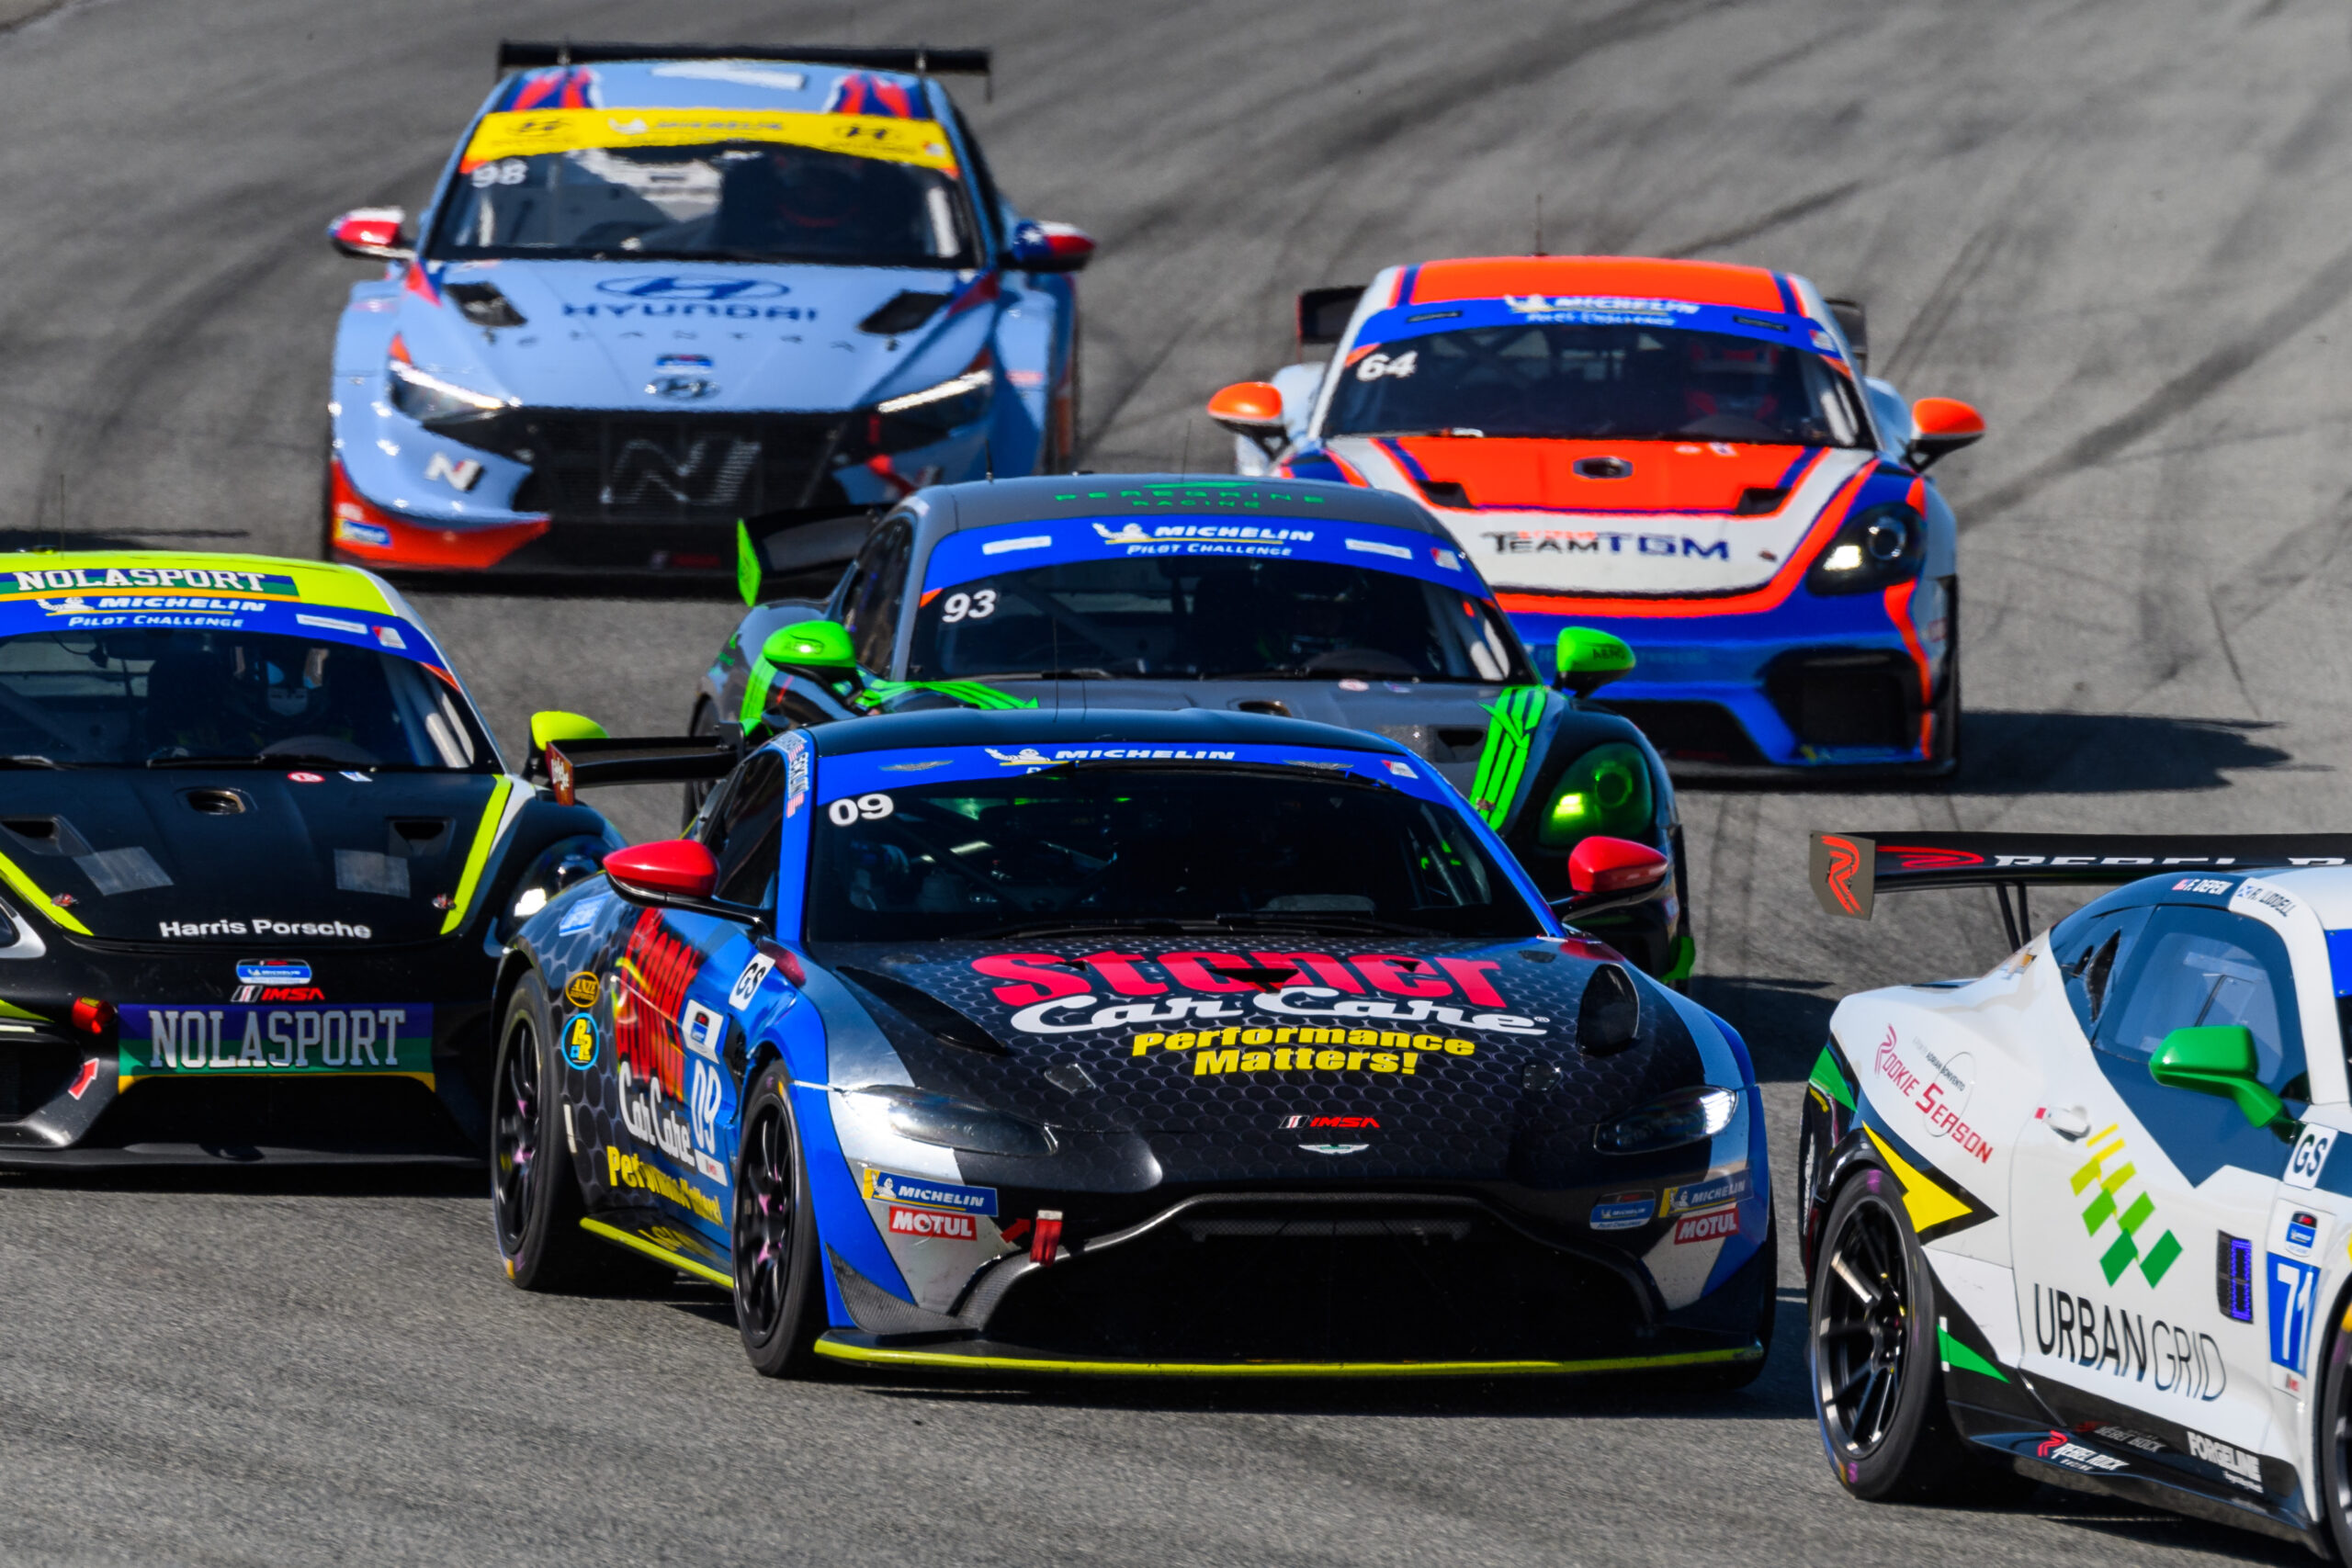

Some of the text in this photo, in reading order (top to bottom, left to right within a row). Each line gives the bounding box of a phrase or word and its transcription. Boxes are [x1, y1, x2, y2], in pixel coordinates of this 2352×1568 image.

[471, 158, 529, 187] 98
[562, 303, 818, 321] HYUNDAI
[1355, 350, 1419, 382] 64
[1154, 525, 1315, 542] MICHELIN
[1126, 543, 1294, 557] PILOT CHALLENGE
[12, 568, 266, 592] NOLASPORT
[97, 596, 267, 612] MICHELIN
[942, 589, 998, 624] 93
[68, 614, 244, 628] PILOT CHALLENGE
[1055, 749, 1236, 761] MICHELIN
[828, 793, 895, 827] 09
[158, 919, 372, 939] Harris Porsche
[261, 987, 325, 1002] IMSA
[736, 962, 767, 1000] GS
[971, 950, 1508, 1010] Stoner
[1011, 994, 1244, 1034] Car
[149, 1010, 406, 1068] NOLASPORT
[1132, 1026, 1476, 1056] Performance
[1193, 1046, 1419, 1076] Matters!
[691, 1059, 723, 1156] 09
[1309, 1116, 1381, 1129] IMSA
[1915, 1082, 1995, 1165] SEASON
[2293, 1134, 2330, 1178] GS
[898, 1185, 985, 1207] MICHELIN
[1690, 1179, 1746, 1204] MICHELIN
[892, 1210, 973, 1237] MOTUL
[1678, 1213, 1736, 1240] MOTUL
[2277, 1262, 2314, 1372] 71
[2187, 1430, 2263, 1483] FORGELINE
